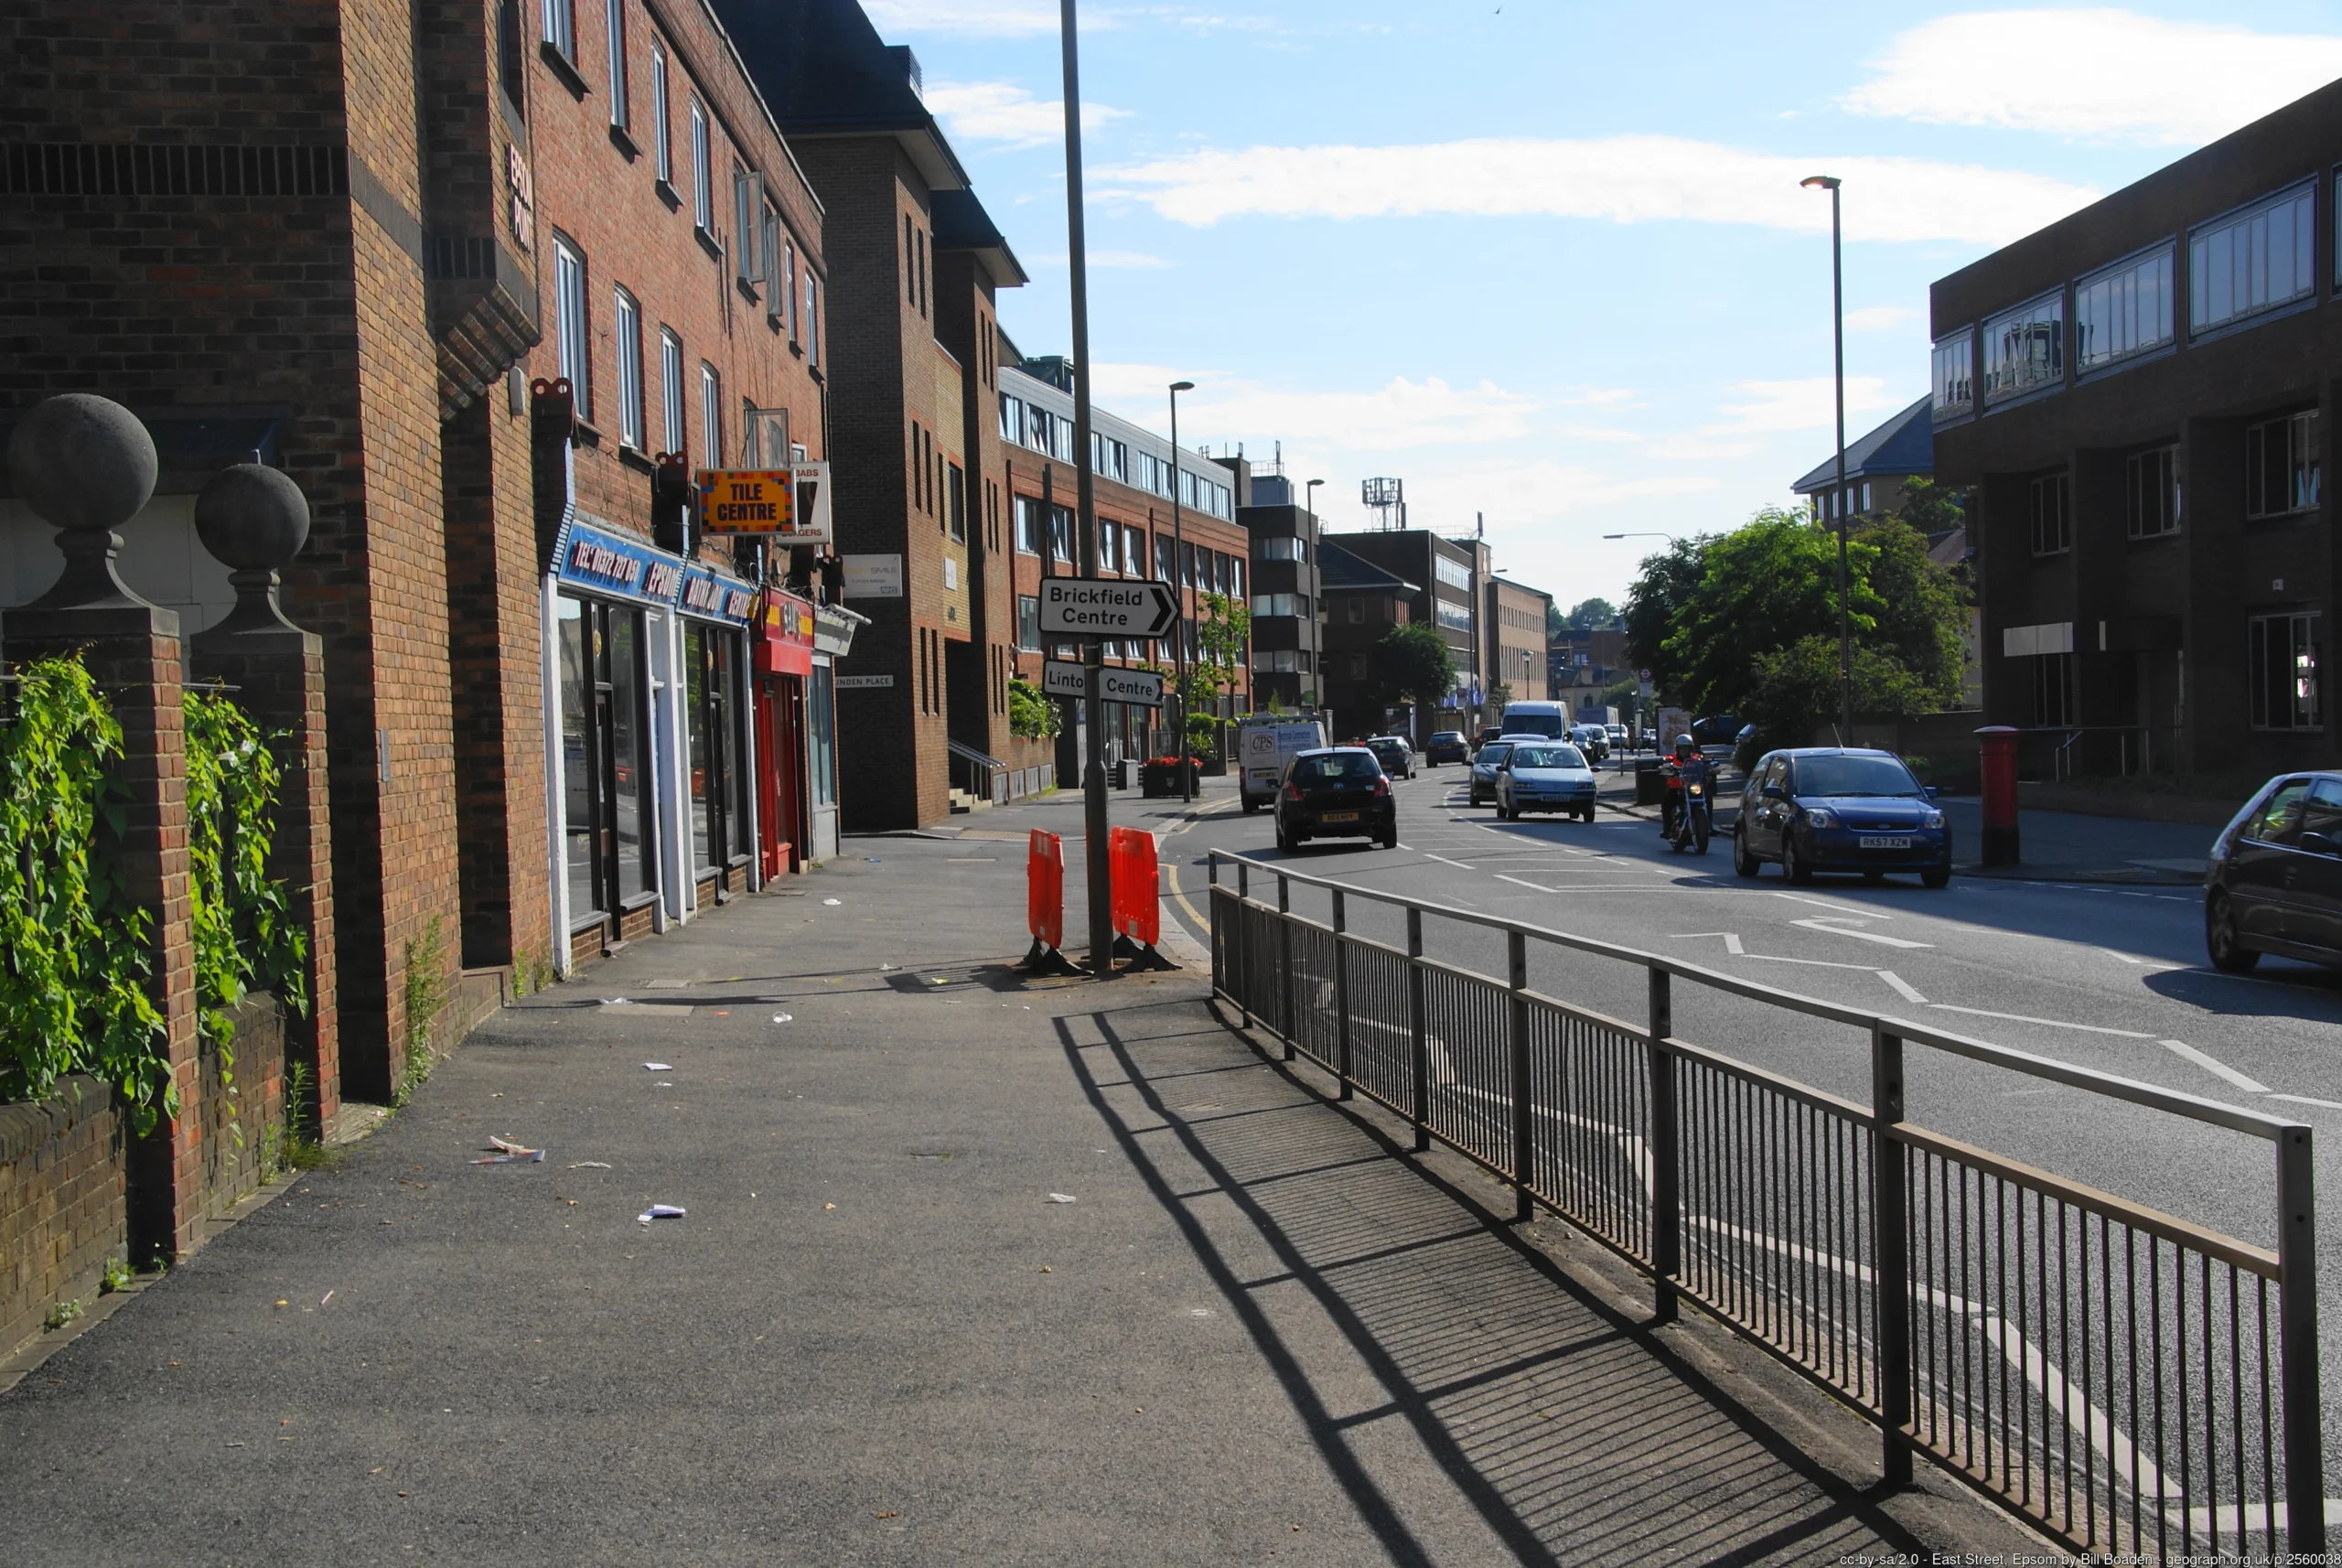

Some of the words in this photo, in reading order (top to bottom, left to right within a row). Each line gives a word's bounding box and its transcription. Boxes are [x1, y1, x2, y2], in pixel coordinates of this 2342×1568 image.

[730, 483, 762, 501] TILE
[717, 502, 777, 521] CENTRE
[1050, 586, 1143, 607] Brickfield
[1062, 607, 1128, 626] Centre
[1048, 671, 1084, 687] Linto
[1107, 678, 1153, 696] Centre
[1252, 736, 1273, 750] CPS
